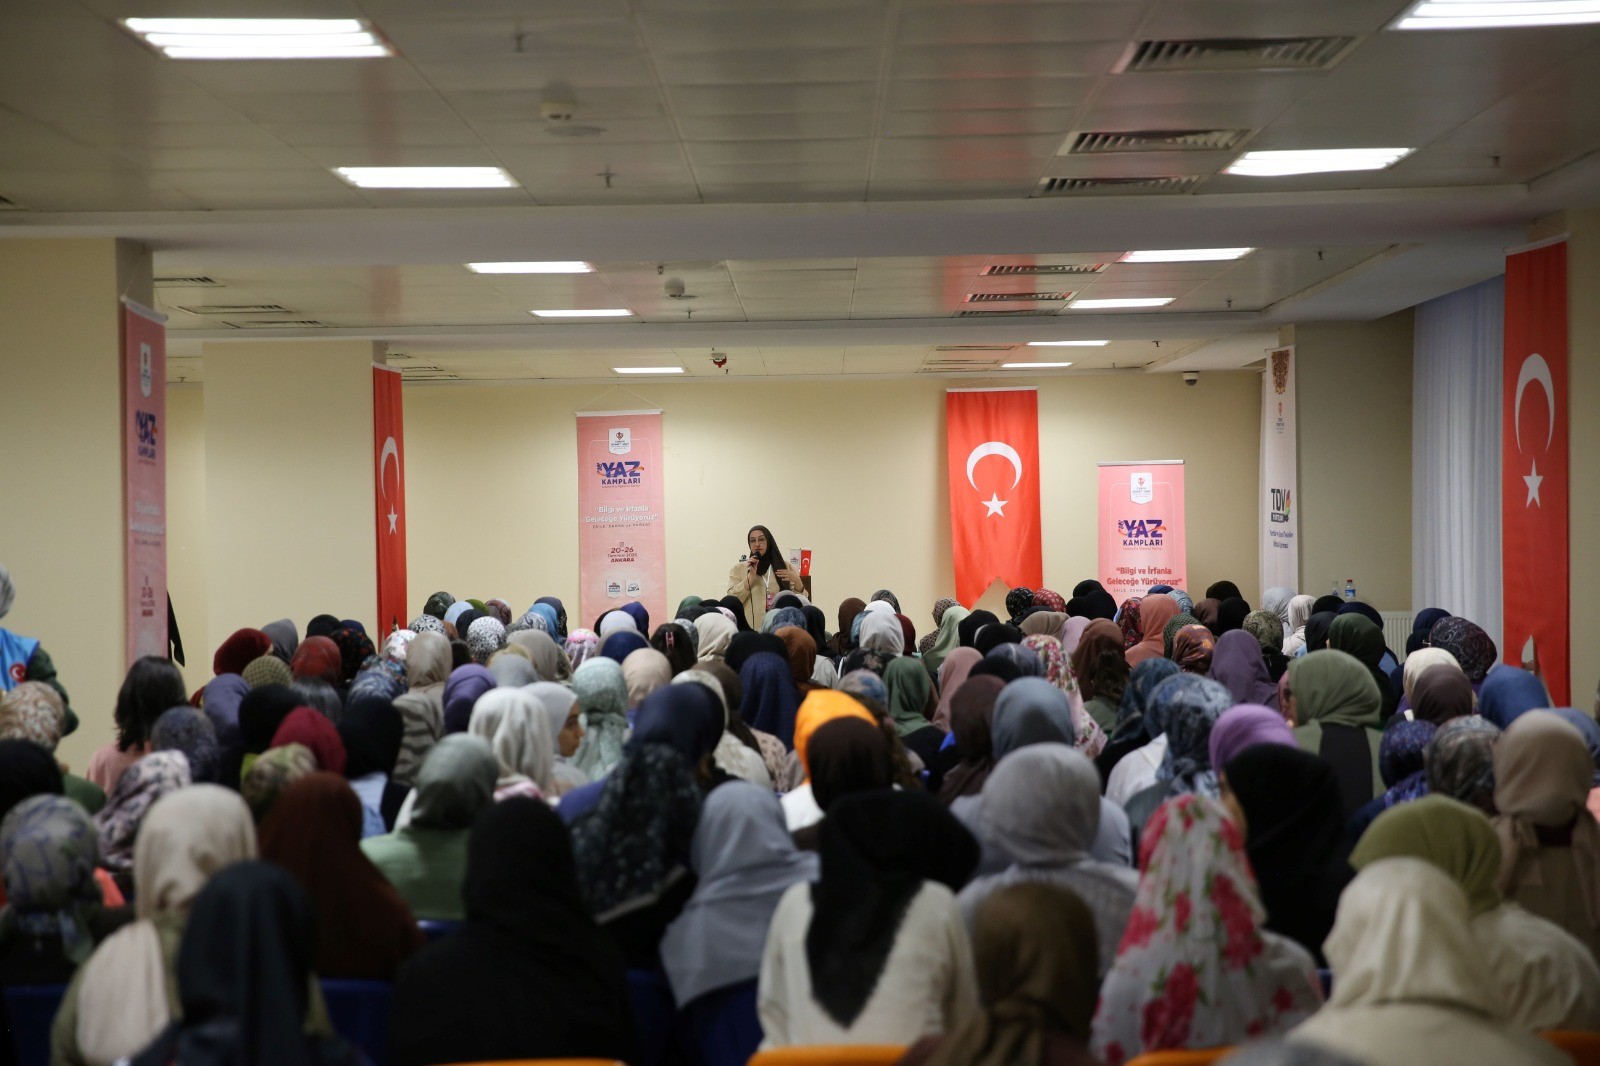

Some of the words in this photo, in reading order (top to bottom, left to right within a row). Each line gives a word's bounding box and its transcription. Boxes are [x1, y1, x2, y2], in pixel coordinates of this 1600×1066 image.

[602, 461, 641, 478] YAZ
[1271, 488, 1286, 511] TDV
[1123, 519, 1163, 538] YAZ
[1148, 566, 1172, 574] İrfanla
[1107, 578, 1139, 586] Geleceğe
